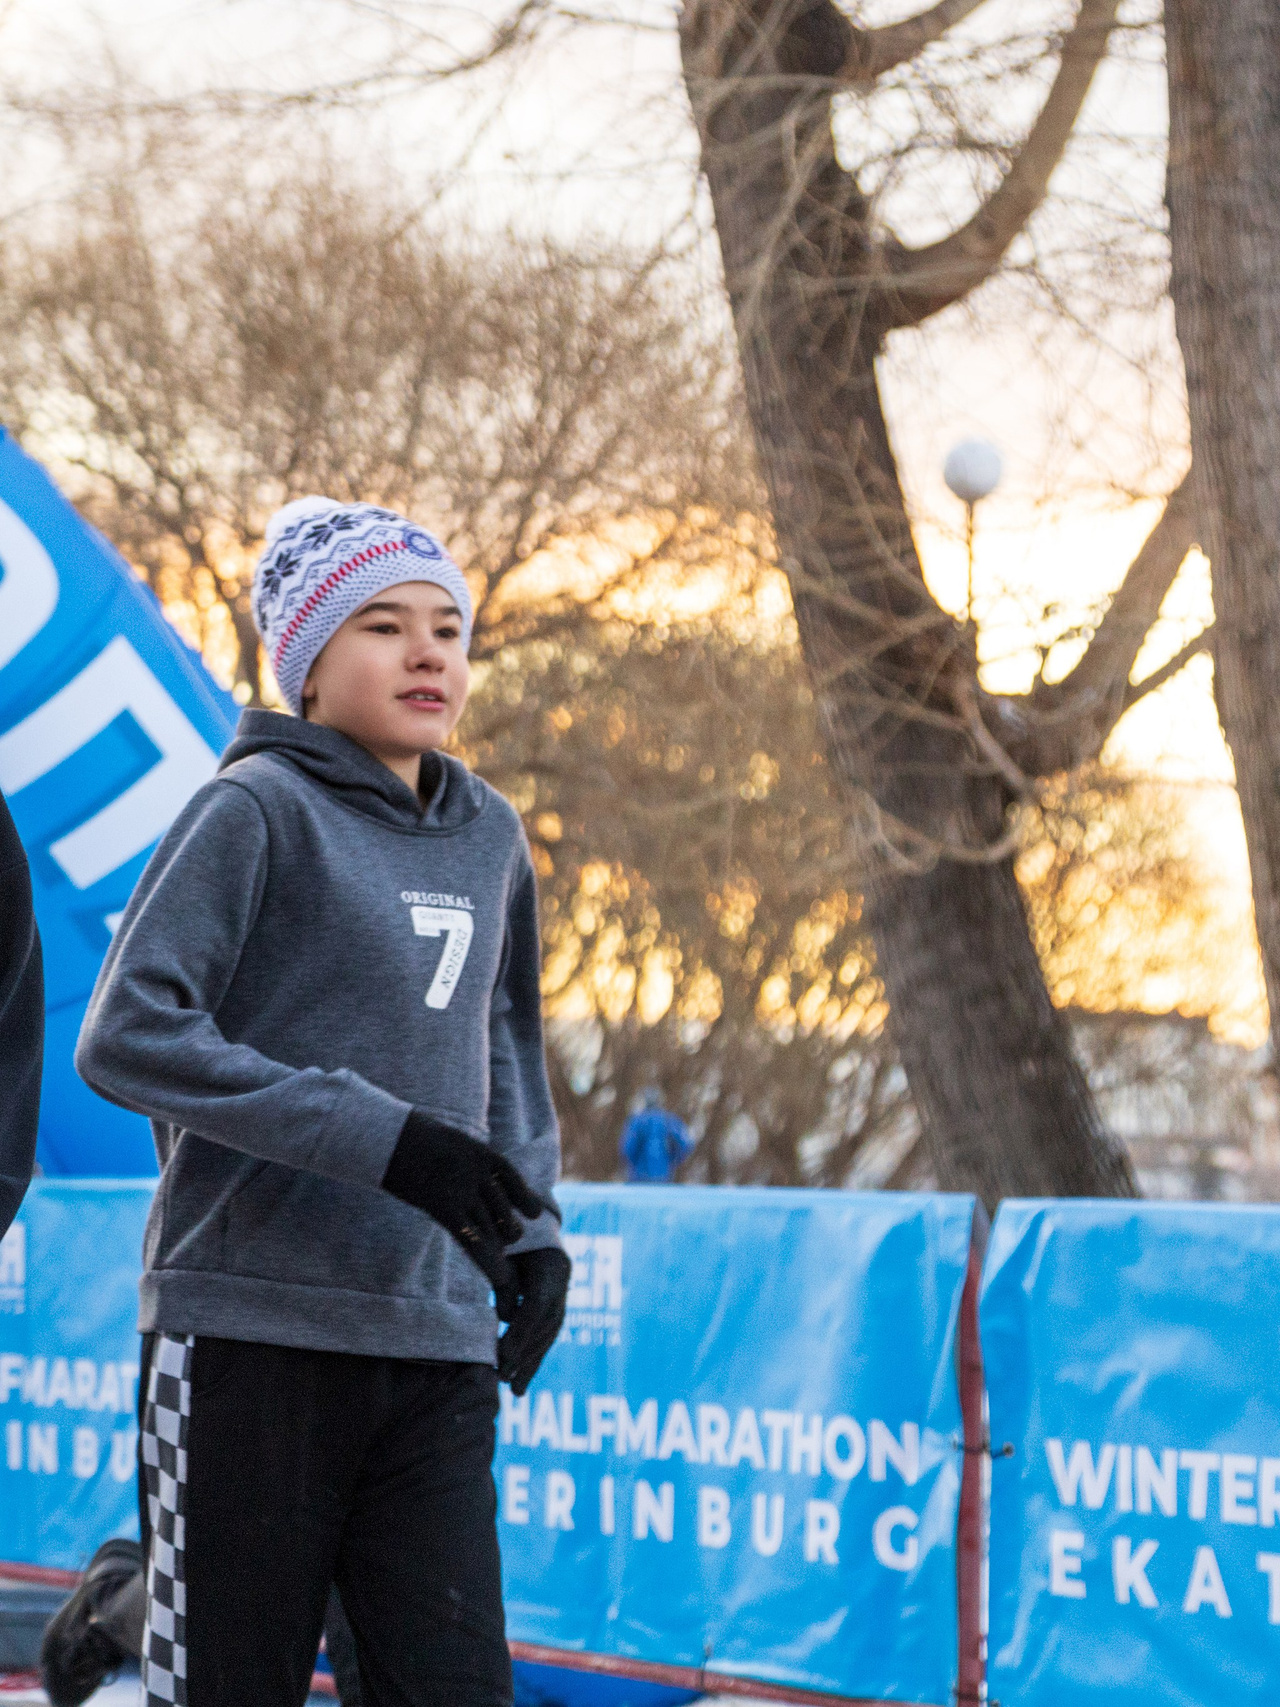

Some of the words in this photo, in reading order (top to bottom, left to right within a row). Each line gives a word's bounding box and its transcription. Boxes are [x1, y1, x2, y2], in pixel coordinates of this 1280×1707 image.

[400, 890, 475, 910] ORIGINAL
[410, 906, 474, 1009] 7
[501, 1385, 920, 1486] HALFMARATHON
[504, 1464, 920, 1572] ERINBURG
